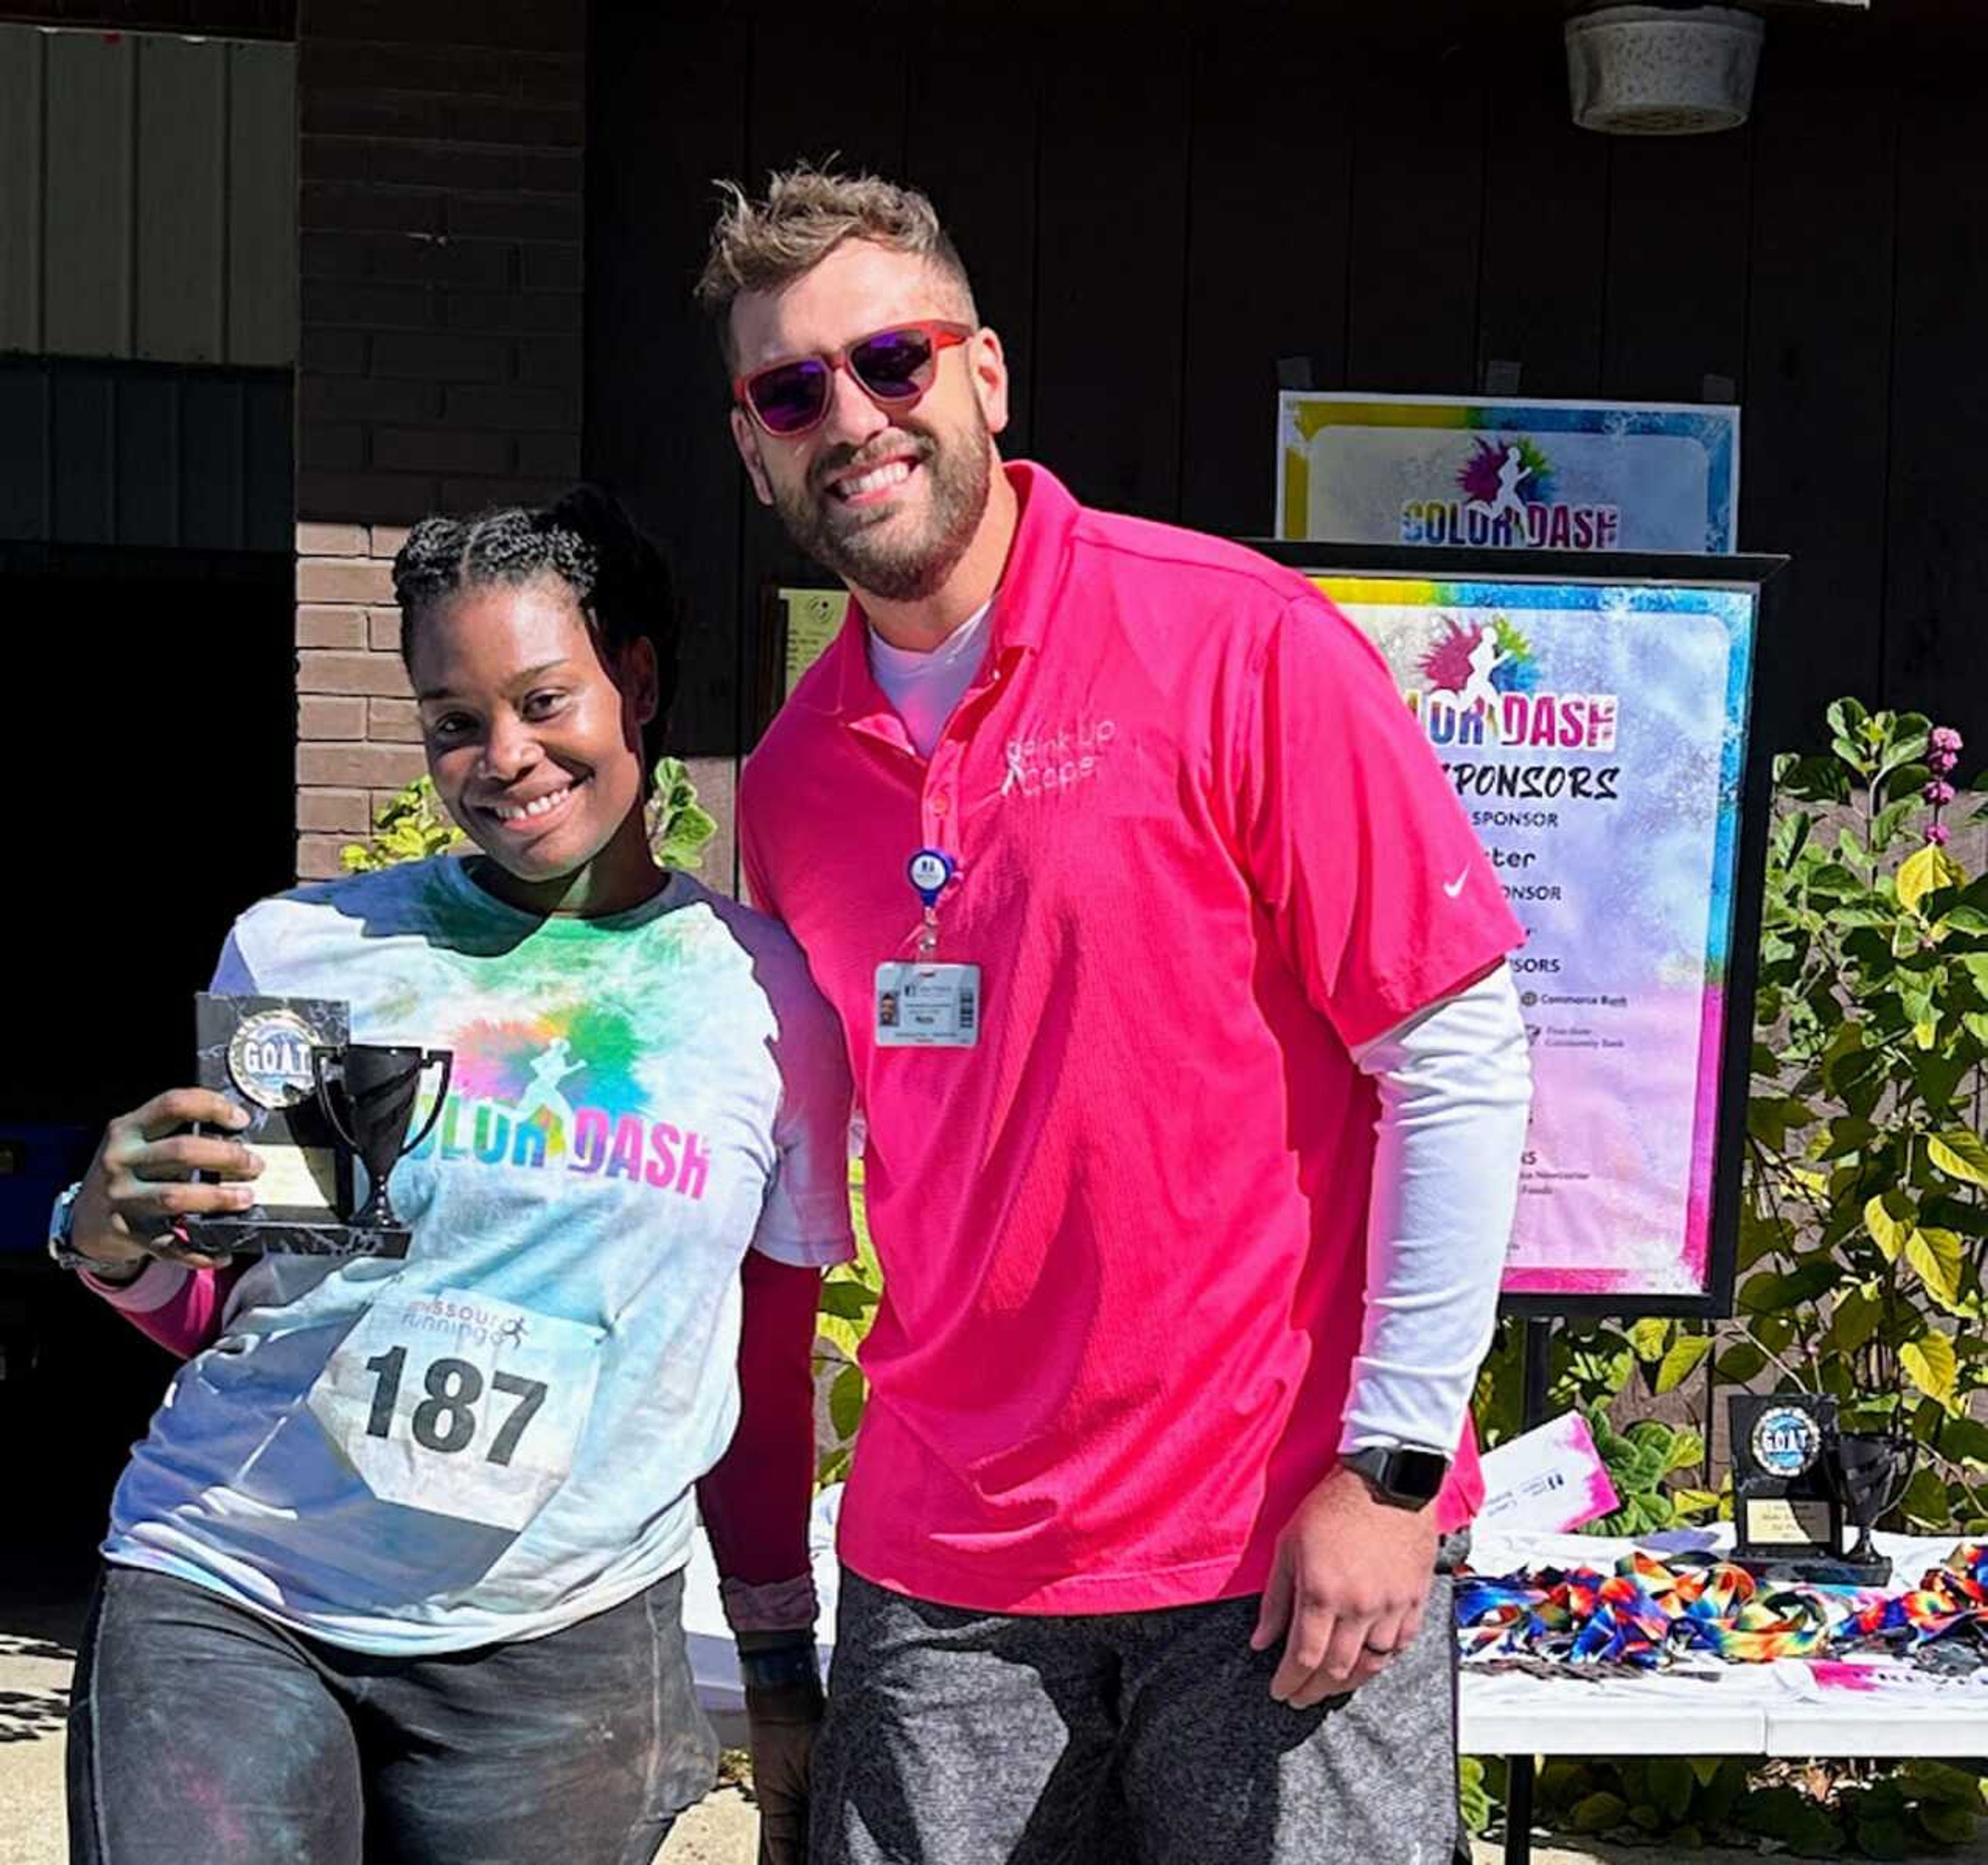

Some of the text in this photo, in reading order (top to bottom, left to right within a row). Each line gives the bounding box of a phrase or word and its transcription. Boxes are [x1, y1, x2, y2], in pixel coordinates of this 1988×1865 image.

[1403, 500, 1617, 548] COLOR DASH
[1501, 694, 1614, 747] DASH
[1442, 763, 1621, 800] PONSORS
[1472, 811, 1559, 828] SPONSOR
[244, 1041, 312, 1073] GOAT
[567, 1106, 711, 1200] DASH
[366, 1346, 548, 1467] 187
[1762, 1429, 1807, 1452] GOAT
